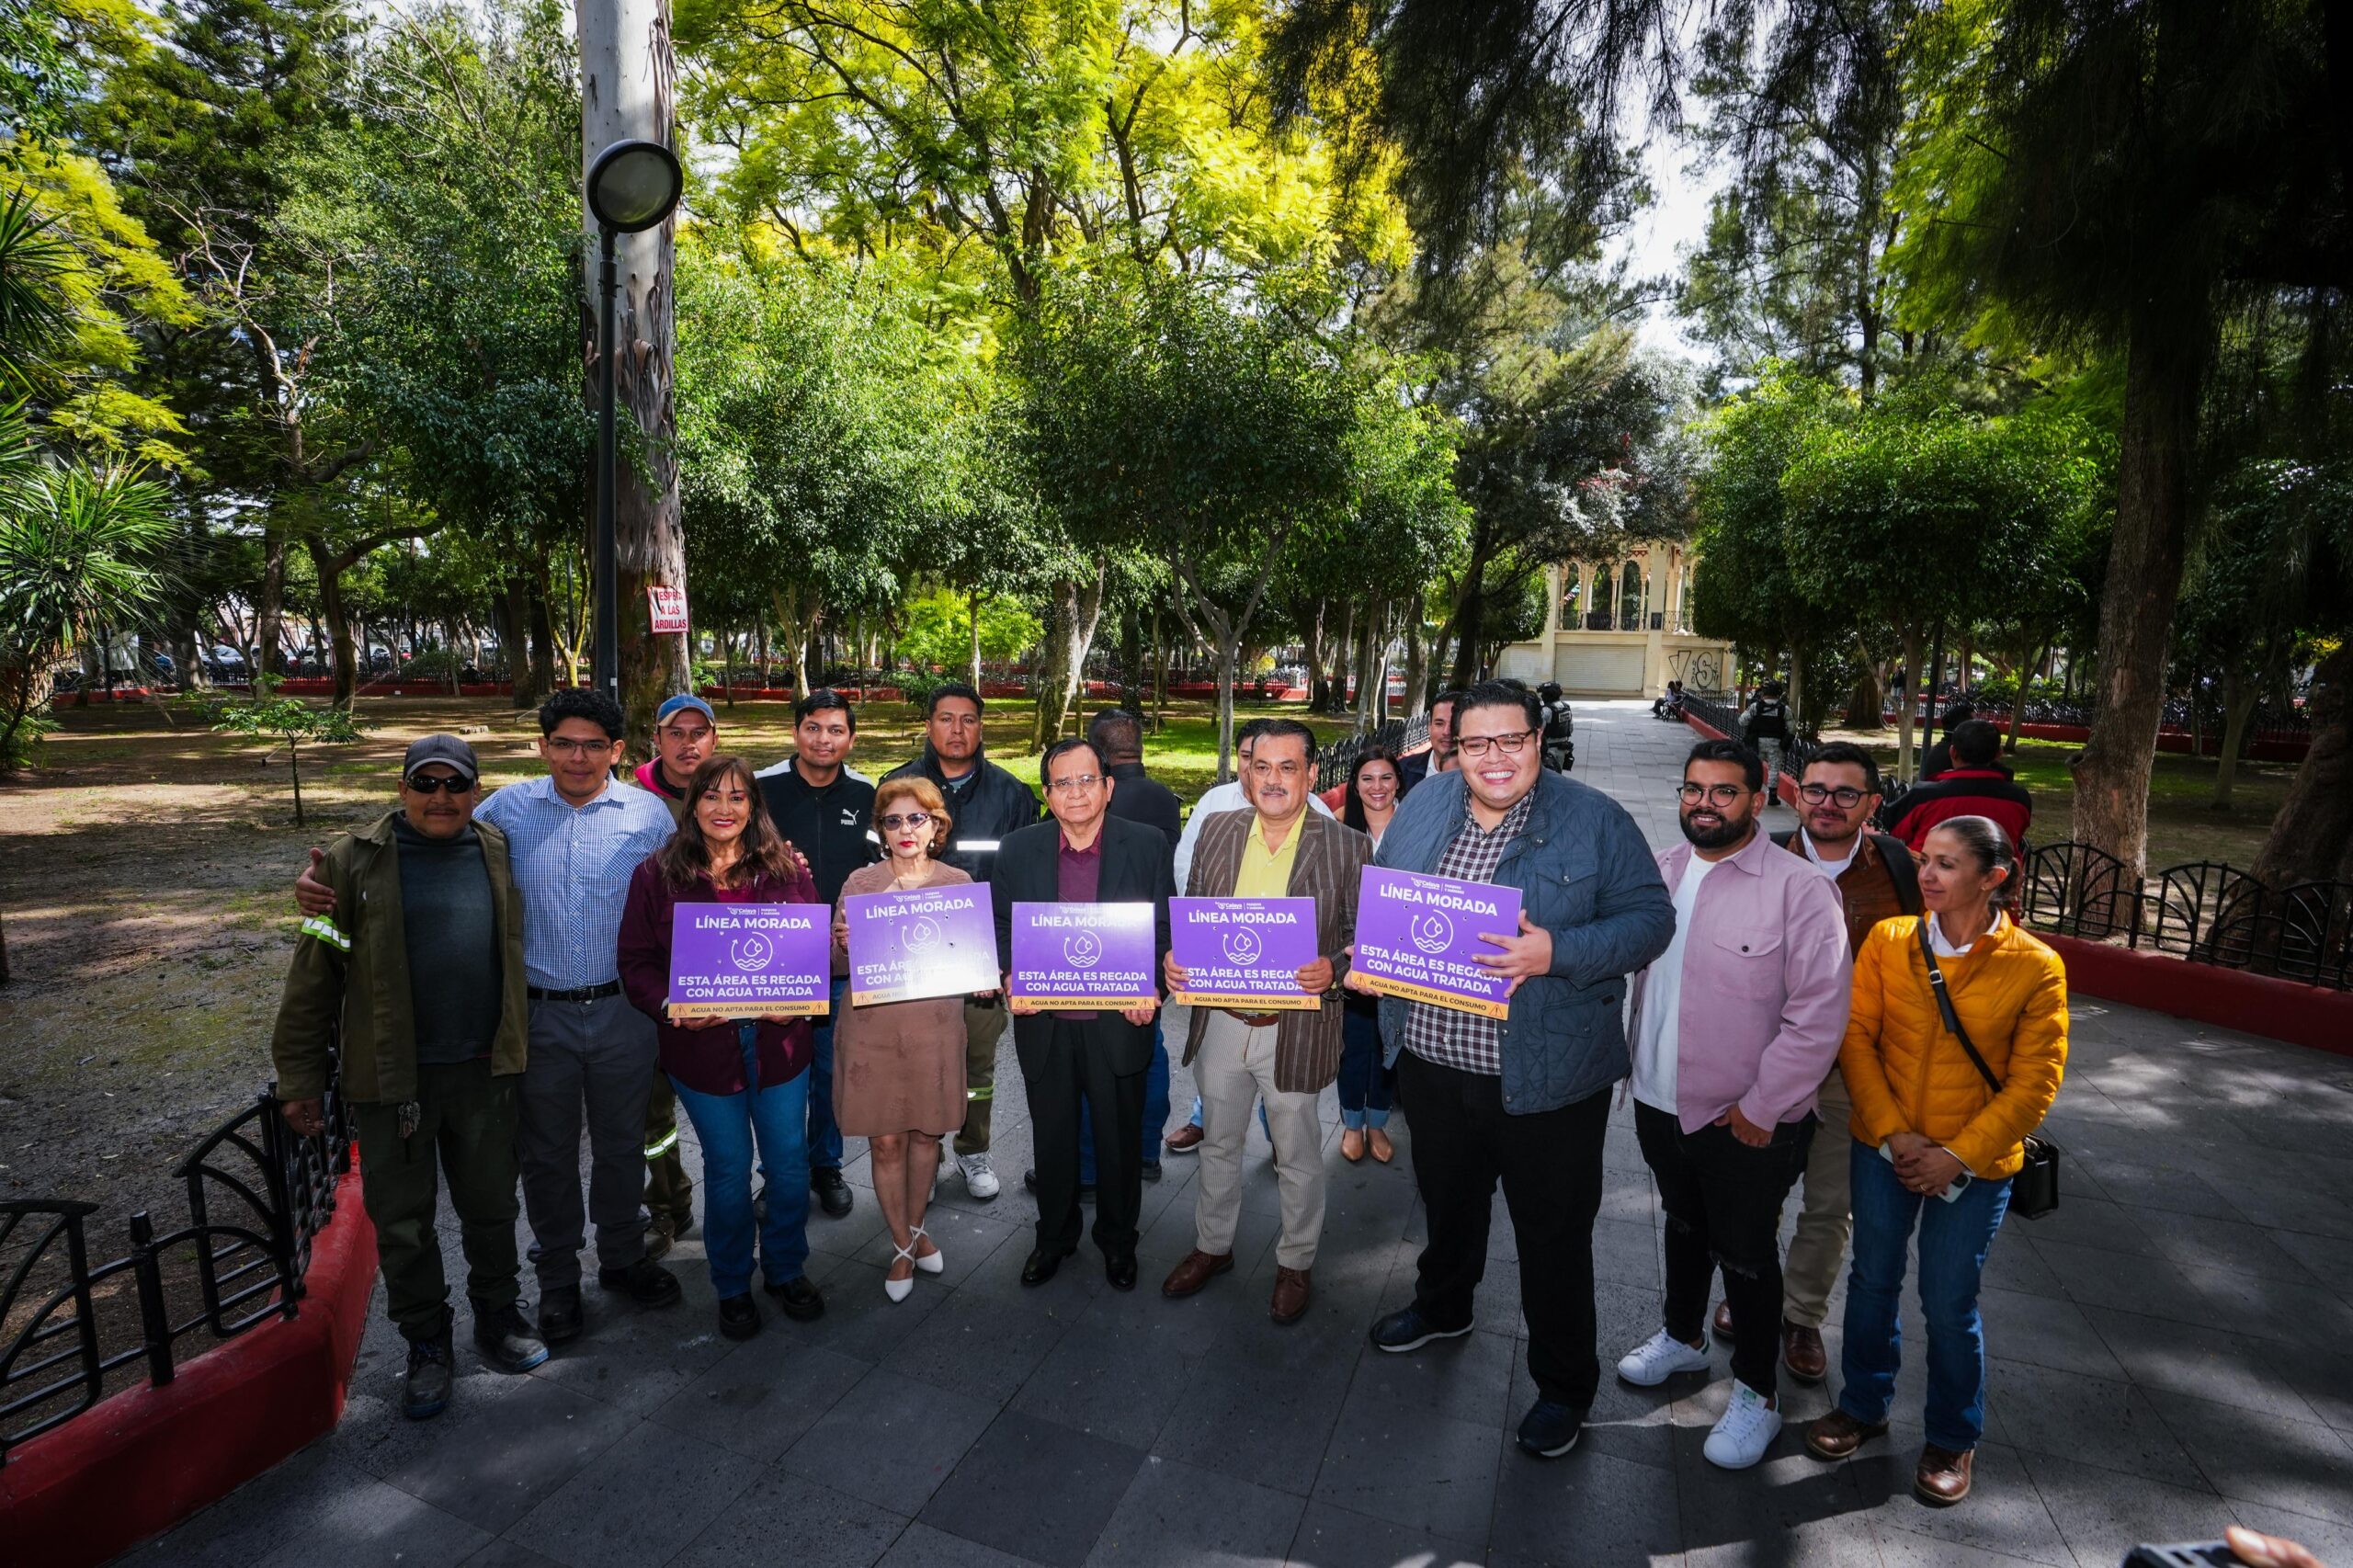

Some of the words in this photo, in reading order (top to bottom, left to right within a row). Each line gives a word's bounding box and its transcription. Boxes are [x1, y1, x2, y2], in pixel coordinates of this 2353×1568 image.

[661, 606, 666, 614] A
[668, 606, 680, 615] LAS
[655, 619, 686, 629] ARDILLAS
[1380, 883, 1423, 904] LÍNEA
[1426, 892, 1498, 916] MORADA
[866, 904, 908, 919] LÍNEA
[911, 898, 974, 914] MORADA
[695, 915, 741, 929] LÍNEA
[744, 918, 811, 929] MORADA
[1032, 914, 1072, 927] LÍNEA
[1188, 909, 1229, 923] LÍNEA
[1233, 912, 1297, 923] MORADA
[1360, 944, 1390, 960] ESTA
[1392, 949, 1426, 967] ÁREA
[1428, 960, 1445, 970] ES
[857, 964, 887, 975] ESTA
[1018, 971, 1047, 981] ESTA
[1049, 970, 1081, 981] ÁREA
[1083, 972, 1097, 981] ES
[1100, 972, 1147, 981] REGADA
[1211, 967, 1241, 978] ÁREA
[1244, 969, 1258, 978] ES
[1261, 970, 1299, 979] REGA
[678, 976, 710, 986] ESTA
[713, 974, 748, 985] ÁREA
[751, 975, 767, 985] ES
[770, 975, 822, 984] REGADA
[866, 974, 891, 985] CON
[1367, 959, 1392, 973] CON
[1394, 966, 1429, 981] AGUA
[1432, 973, 1492, 995] TRATADA
[1026, 983, 1050, 991] CON
[1053, 983, 1085, 991] AGUA
[1087, 983, 1140, 992] TRATADA
[1188, 979, 1212, 988] CON
[1215, 980, 1247, 989] AGUA
[686, 988, 714, 998] CON
[717, 987, 753, 997] AGUA
[756, 987, 813, 996] TRATADA
[1370, 980, 1388, 988] AGUA
[1400, 986, 1418, 996] APTA
[1420, 991, 1438, 1001] PARA
[1449, 997, 1487, 1011] CONSUMO
